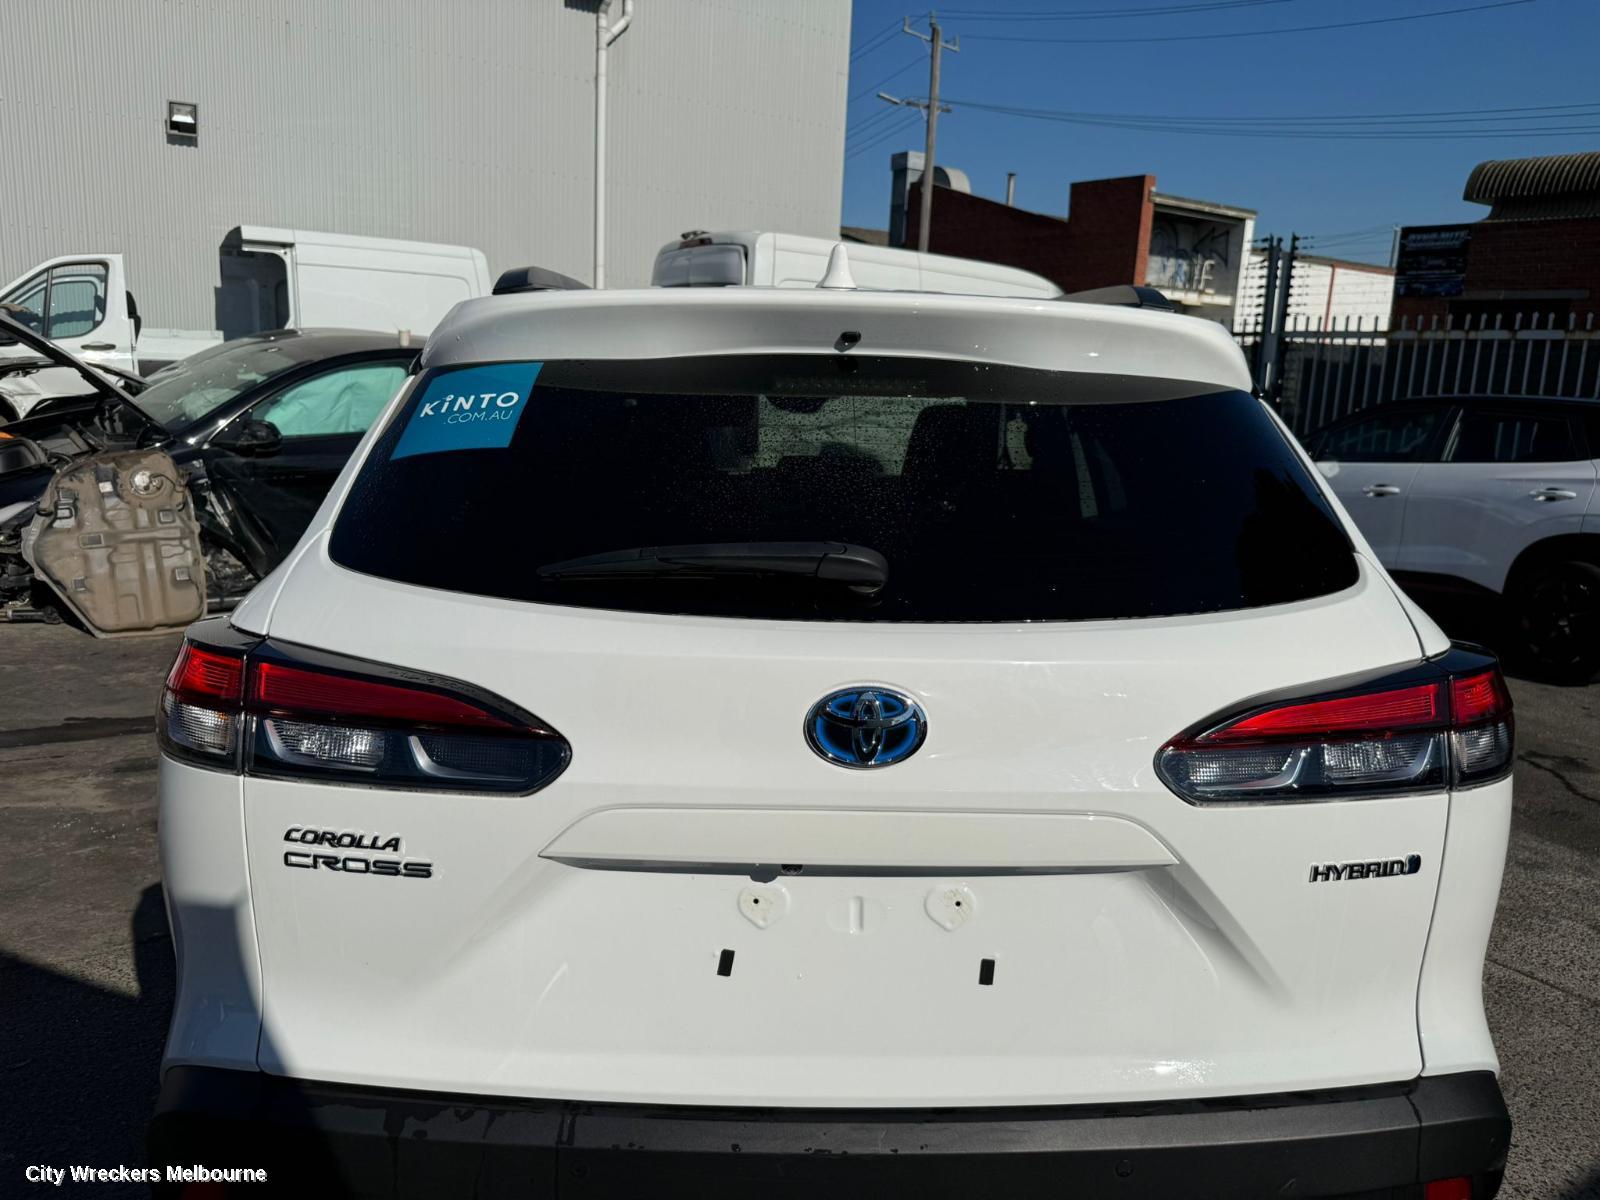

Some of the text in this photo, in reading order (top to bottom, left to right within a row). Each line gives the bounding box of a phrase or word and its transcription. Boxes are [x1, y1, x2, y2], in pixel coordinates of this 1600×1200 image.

[283, 828, 402, 852] COROLLA
[283, 851, 432, 878] CROSS
[1308, 859, 1405, 882] HYBRID
